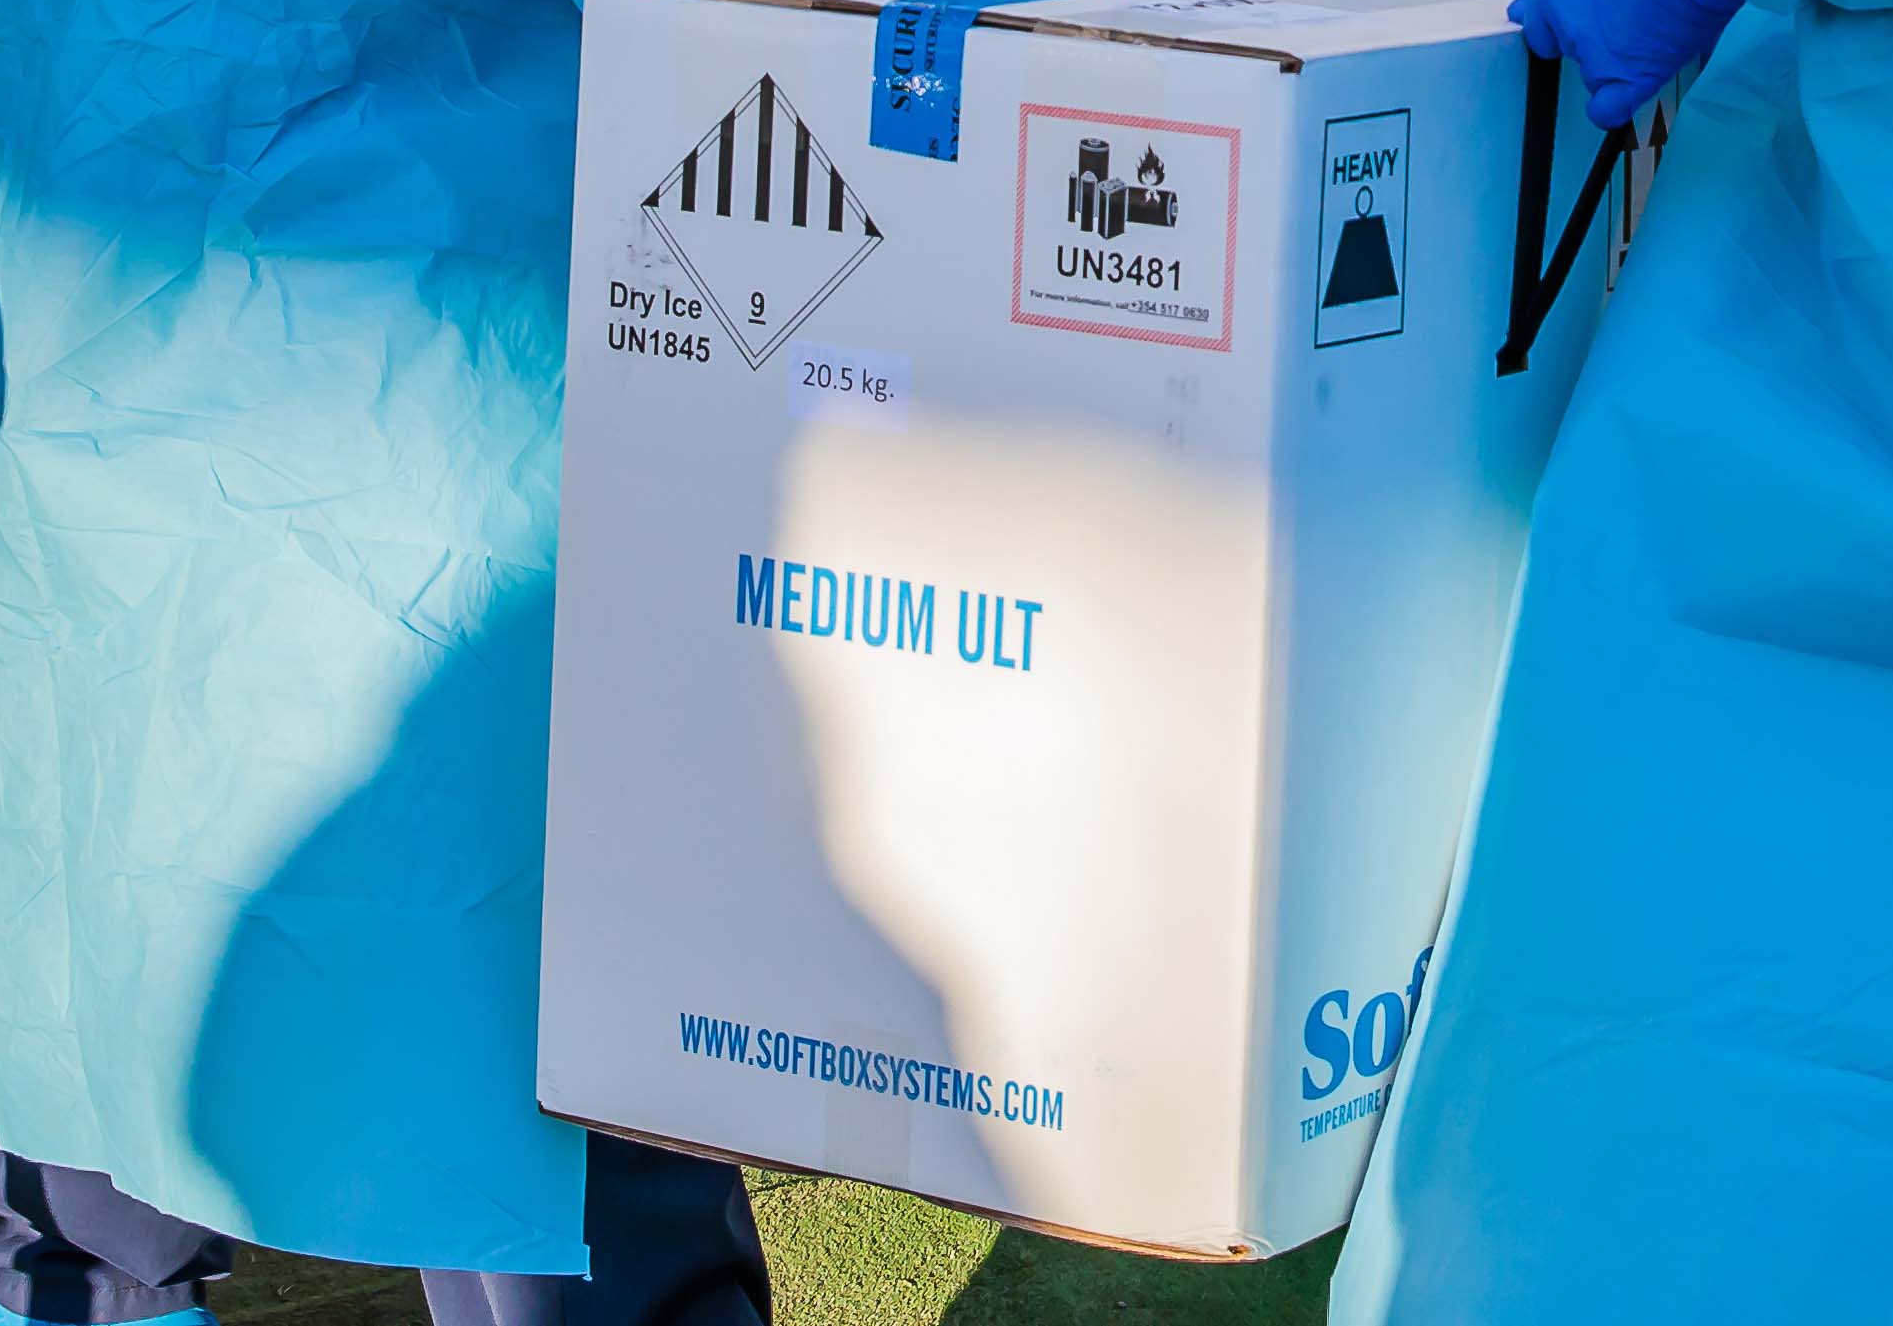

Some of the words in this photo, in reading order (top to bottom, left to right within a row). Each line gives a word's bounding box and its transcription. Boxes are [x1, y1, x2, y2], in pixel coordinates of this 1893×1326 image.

[1332, 149, 1399, 185] HEAVY
[1056, 244, 1181, 292] UN3481
[609, 280, 657, 320] Dry
[659, 284, 703, 320] Ice
[750, 291, 765, 318] 9
[608, 322, 711, 364] UN1845
[802, 361, 854, 392] 20.5
[862, 368, 895, 403] kg.
[735, 553, 936, 656] MEDIUM
[957, 589, 1044, 672] ULT
[679, 1012, 1064, 1132] WWW.SOFTBOXSYSTEMS.COM
[1300, 1088, 1382, 1143] TEMPERATURE
